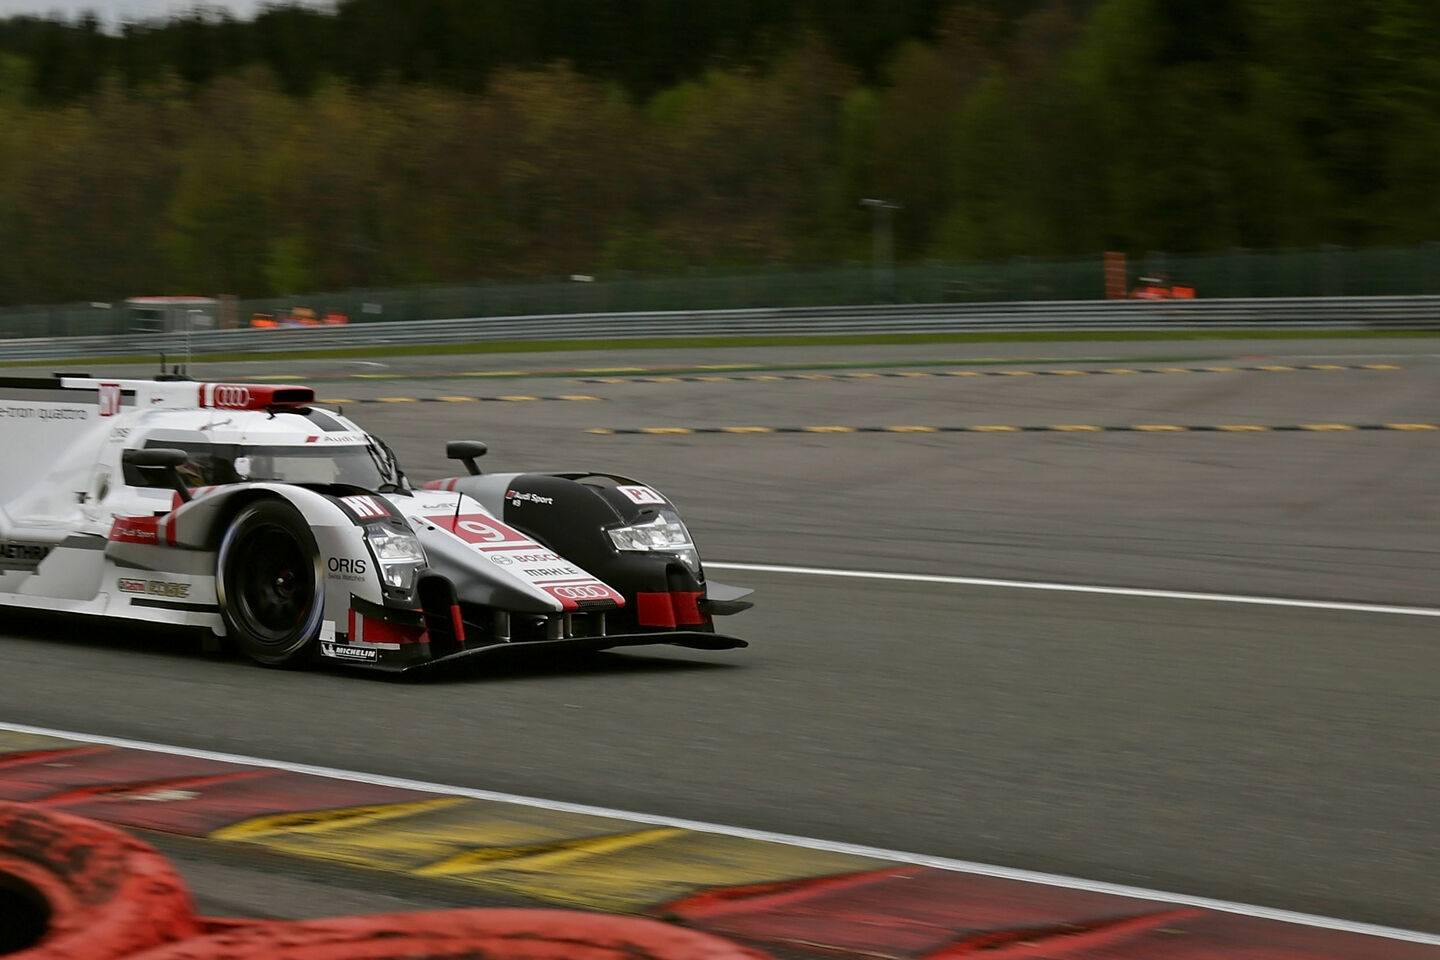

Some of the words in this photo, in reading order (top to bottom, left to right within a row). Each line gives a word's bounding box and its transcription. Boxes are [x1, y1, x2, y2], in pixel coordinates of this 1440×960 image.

[517, 491, 531, 500] Audi
[531, 493, 553, 504] Sport
[629, 489, 658, 500] P1
[342, 496, 385, 517] HY
[457, 521, 506, 542] 9
[328, 557, 366, 574] ORIS
[524, 567, 579, 576] MAHLE
[148, 581, 191, 598] EDGE
[336, 647, 375, 657] MICHELIN
